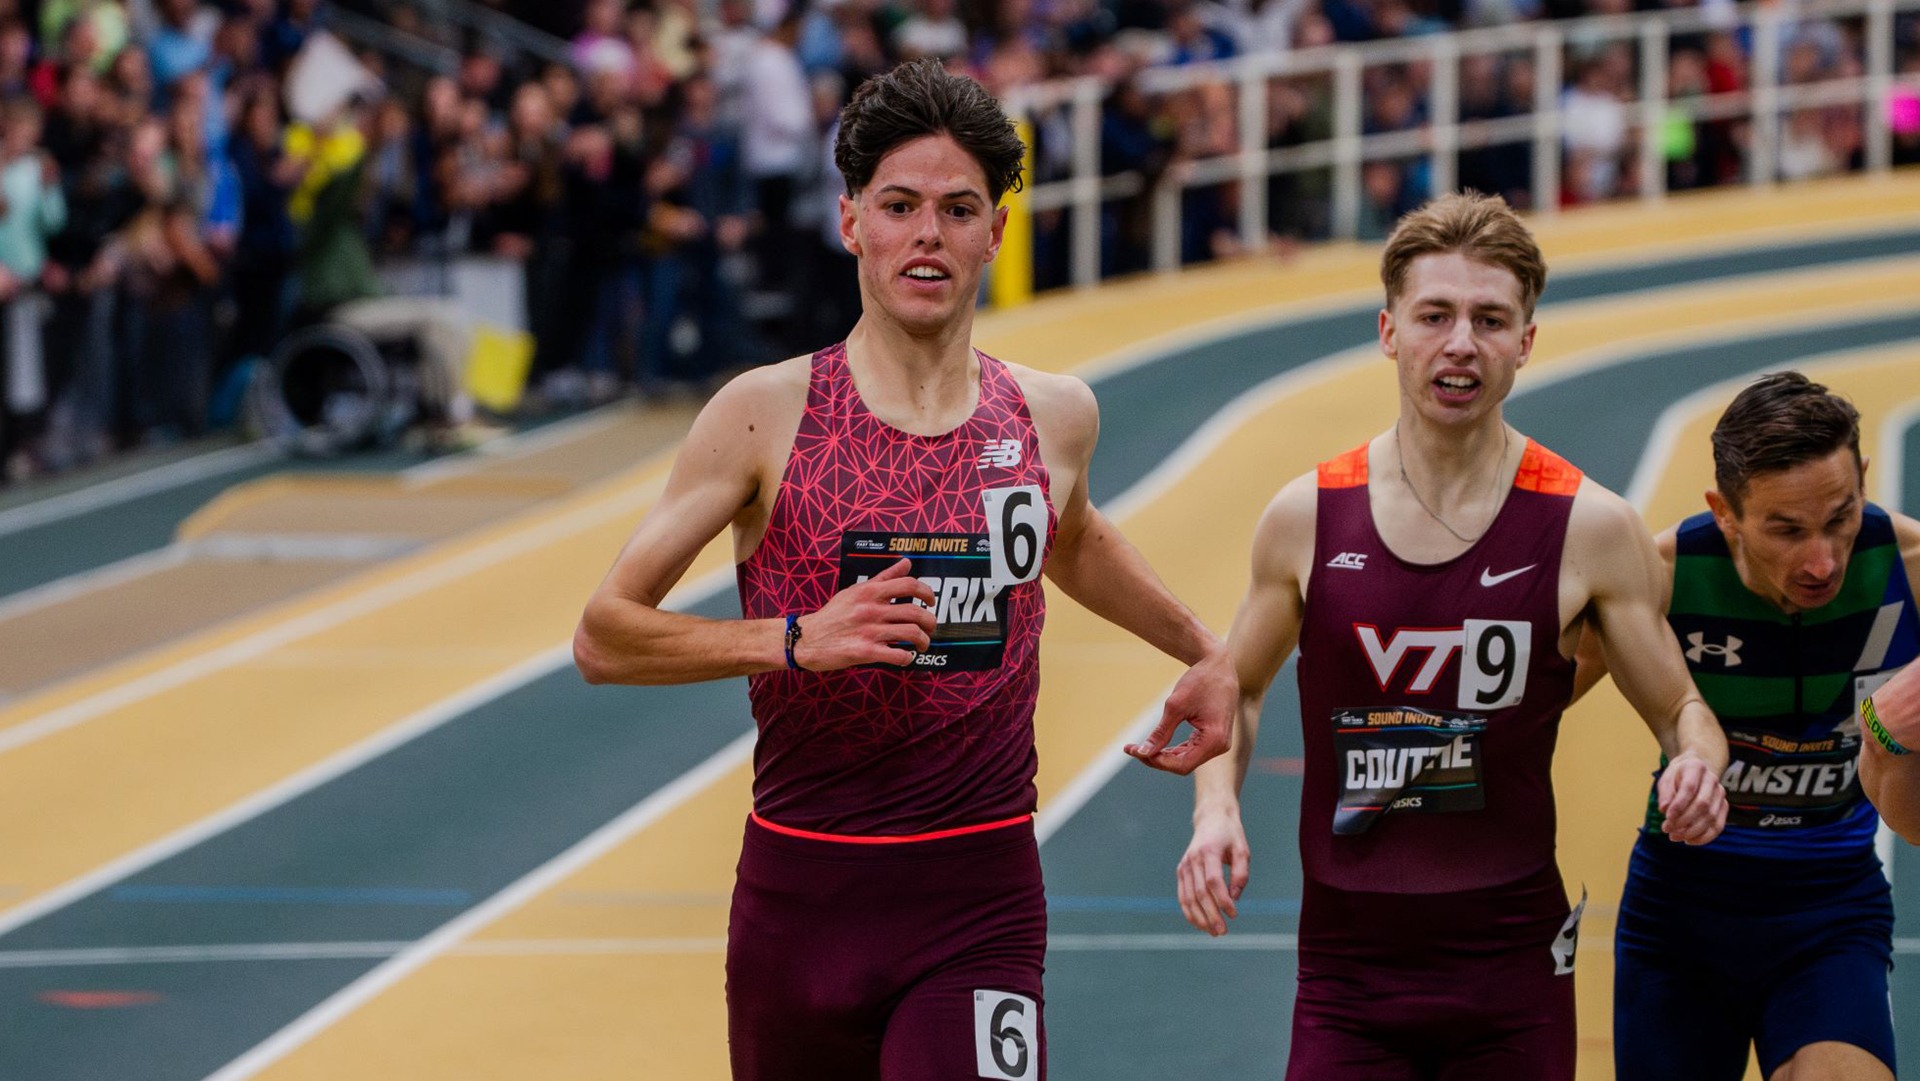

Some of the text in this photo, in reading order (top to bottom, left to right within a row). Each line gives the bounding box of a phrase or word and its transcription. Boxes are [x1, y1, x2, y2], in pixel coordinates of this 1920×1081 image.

[889, 538, 968, 552] SOUND INVITE
[1001, 491, 1037, 580] 6
[1327, 552, 1368, 569] ACC
[1352, 622, 1464, 694] VT
[1475, 624, 1516, 705] 9
[1367, 712, 1403, 726] SOUND
[1404, 711, 1443, 727] INVITE
[1761, 734, 1798, 753] SOUND
[1800, 739, 1835, 751] INVITE
[1721, 755, 1859, 797] ANSTEY
[990, 998, 1028, 1078] 6
